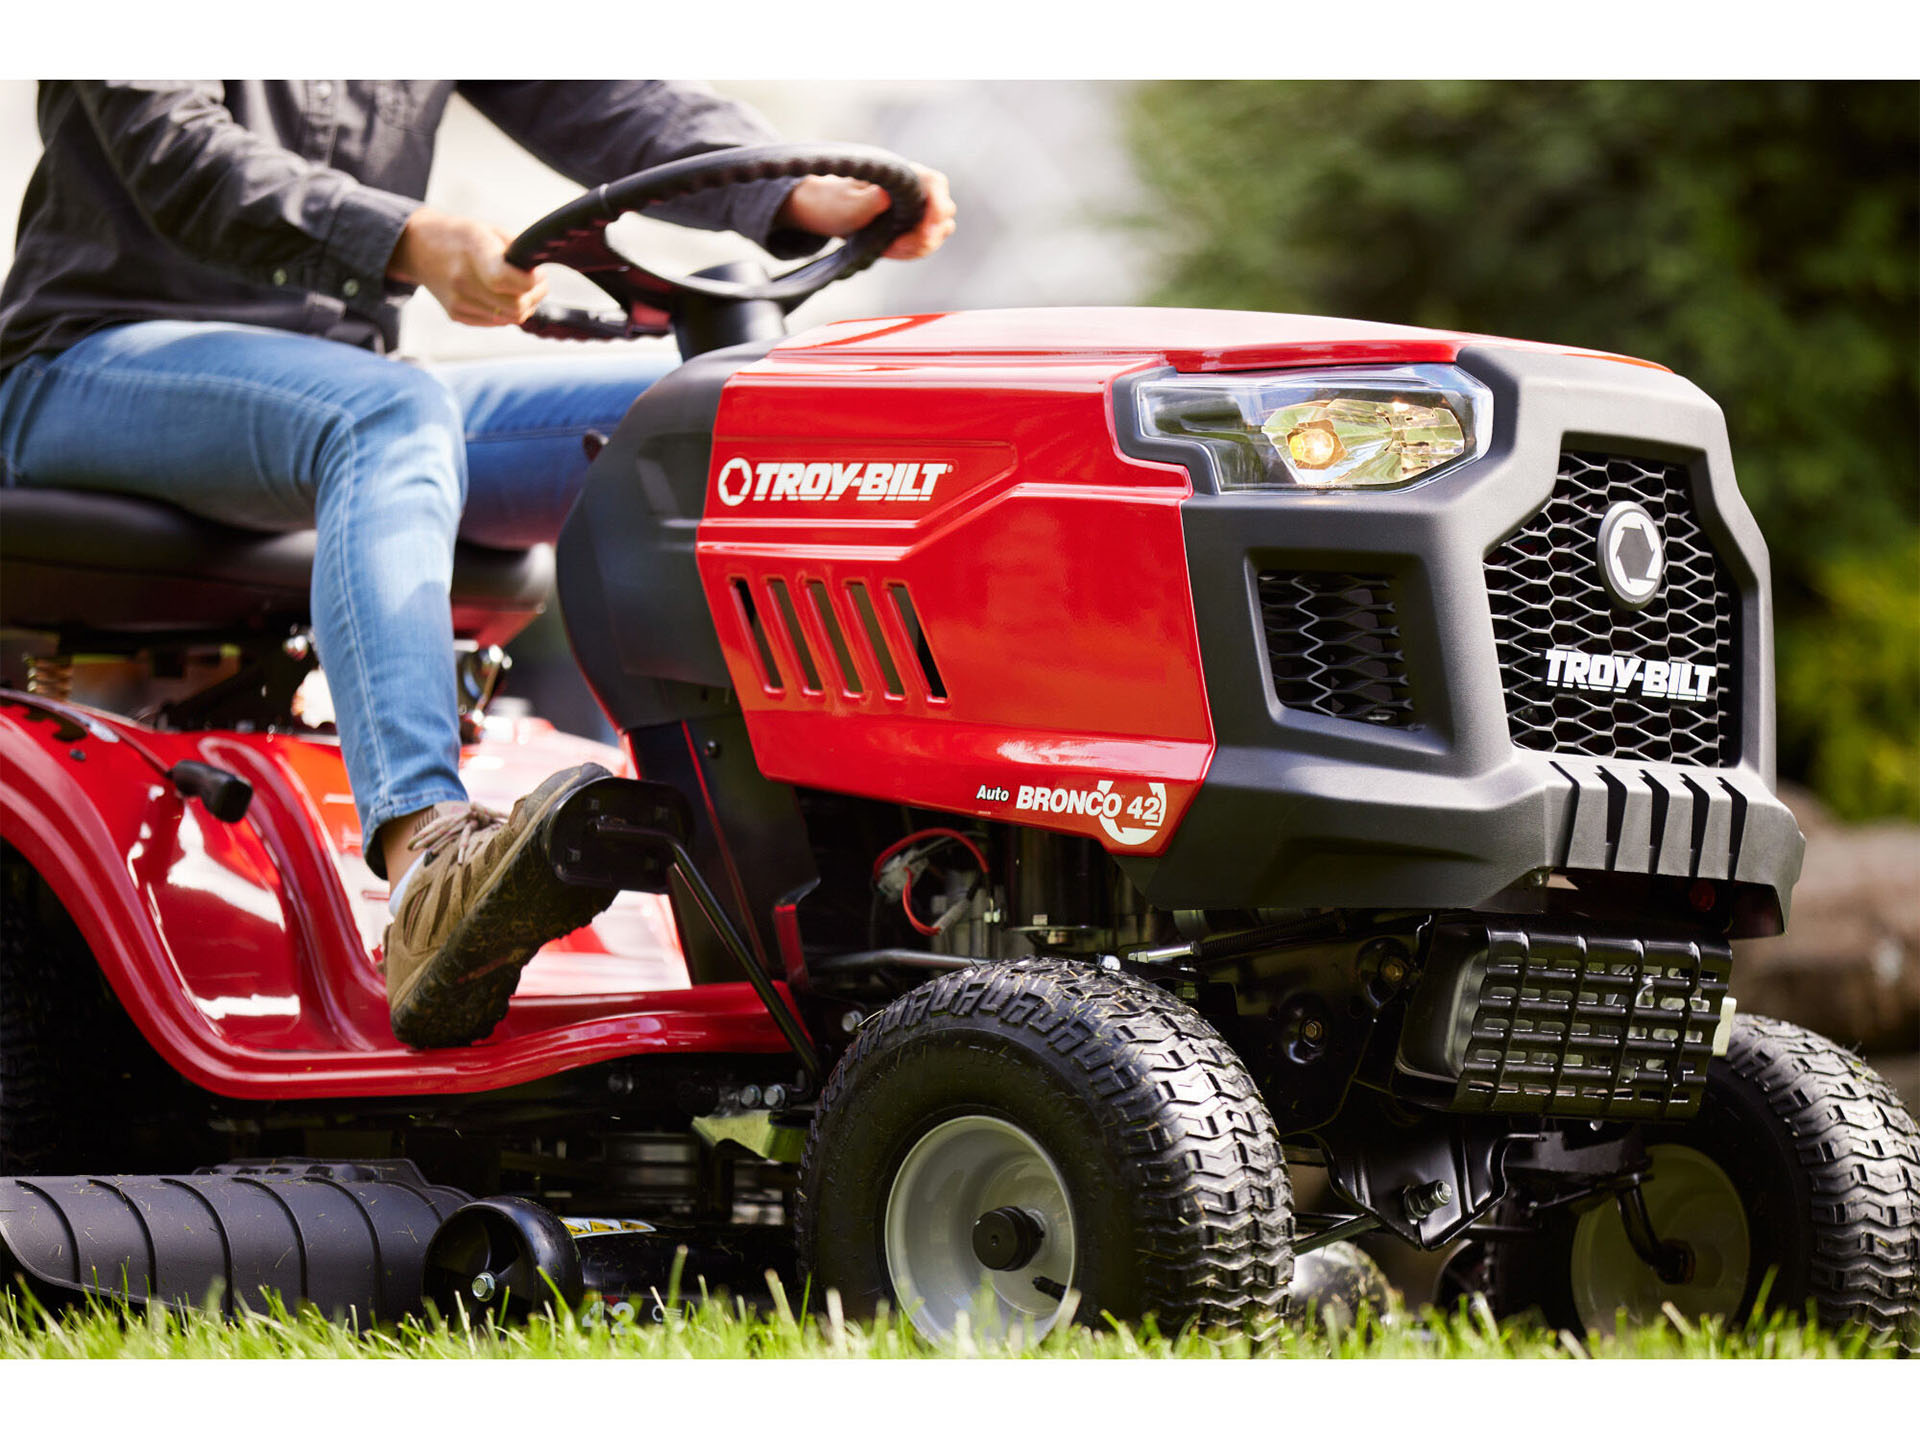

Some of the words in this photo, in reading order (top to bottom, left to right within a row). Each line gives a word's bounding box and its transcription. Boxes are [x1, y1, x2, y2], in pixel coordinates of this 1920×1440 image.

[1545, 649, 1717, 702] TROY-BILT
[976, 785, 1009, 801] Auto
[1016, 785, 1122, 817] BRONCO
[1127, 796, 1160, 820] 42
